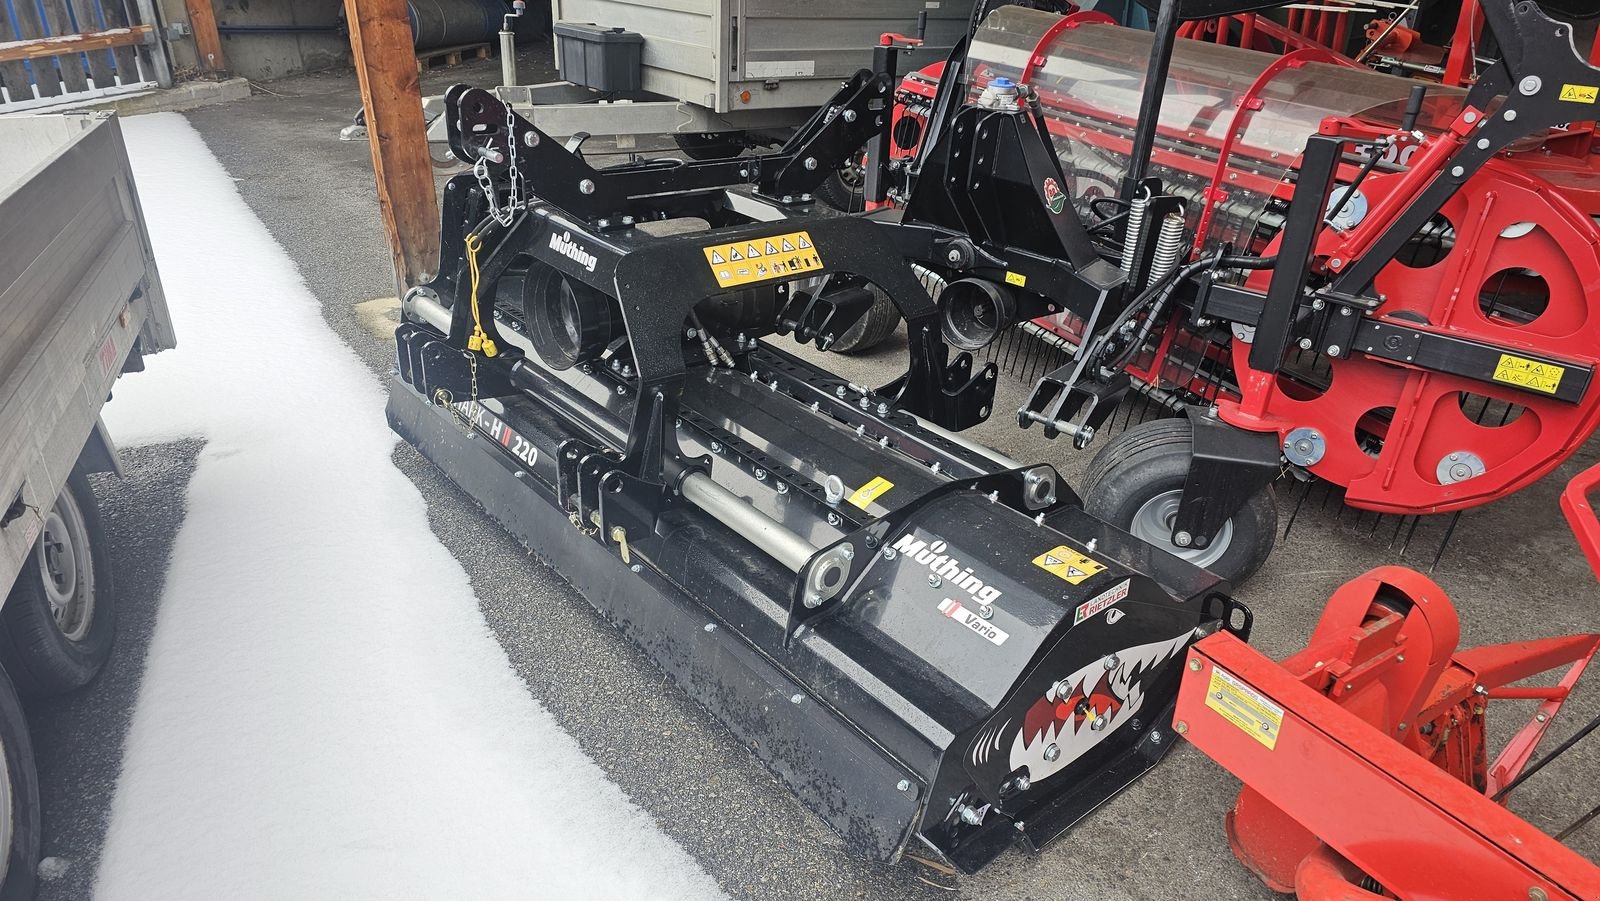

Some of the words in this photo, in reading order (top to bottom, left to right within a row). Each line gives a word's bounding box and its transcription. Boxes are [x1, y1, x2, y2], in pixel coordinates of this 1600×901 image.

[511, 435, 538, 467] 220
[892, 533, 1003, 606] Müthing
[1088, 587, 1128, 616] RIETZLER
[964, 613, 997, 640] Vario
